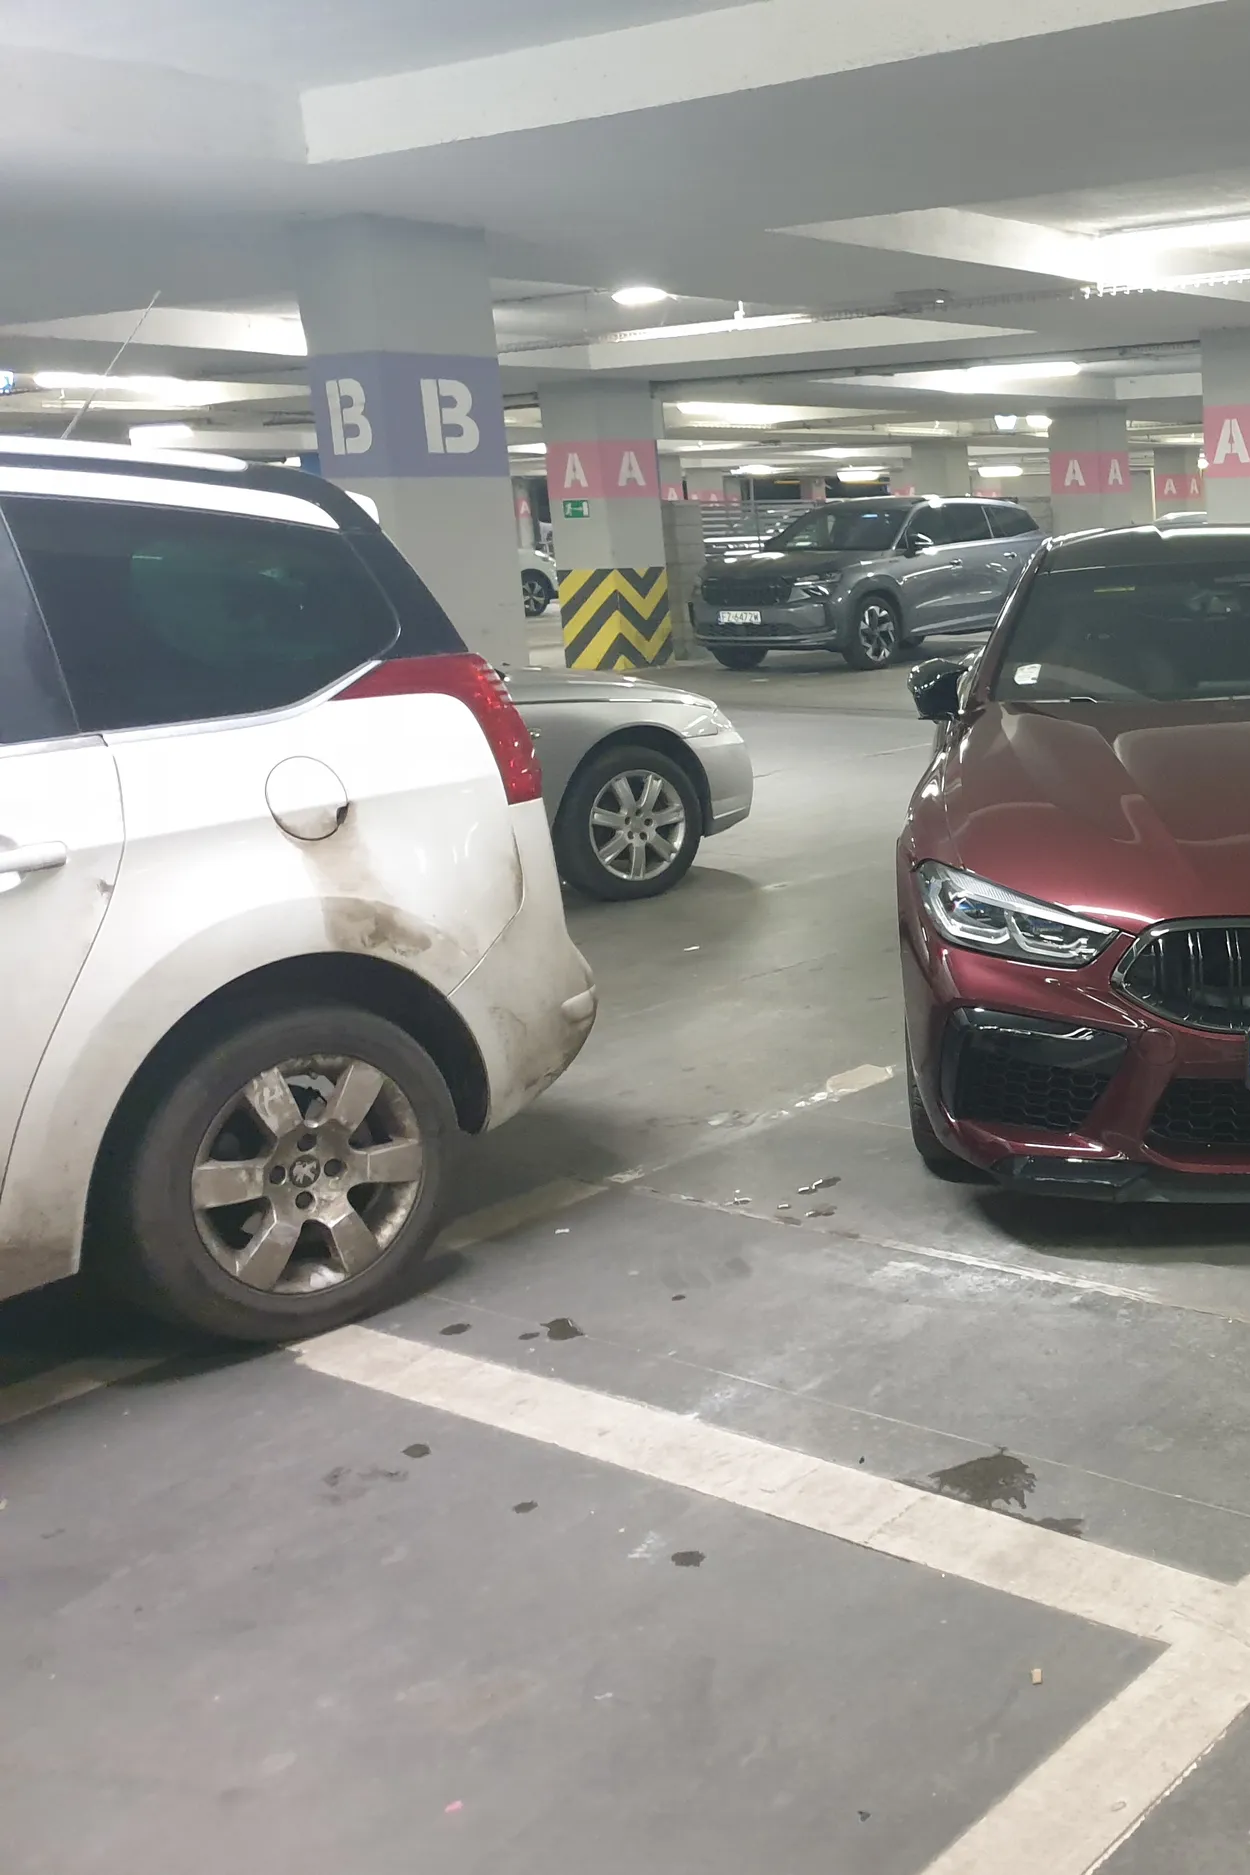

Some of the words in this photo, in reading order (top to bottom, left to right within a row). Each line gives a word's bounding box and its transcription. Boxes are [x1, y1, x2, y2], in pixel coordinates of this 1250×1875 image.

[325, 378, 373, 455] B
[420, 378, 480, 454] B
[1213, 418, 1250, 464] A
[563, 452, 589, 488] A
[617, 451, 647, 487] A
[1064, 459, 1086, 487] A
[1107, 459, 1124, 486] A
[1164, 478, 1177, 495] A
[1189, 477, 1200, 494] A
[519, 500, 531, 515] A
